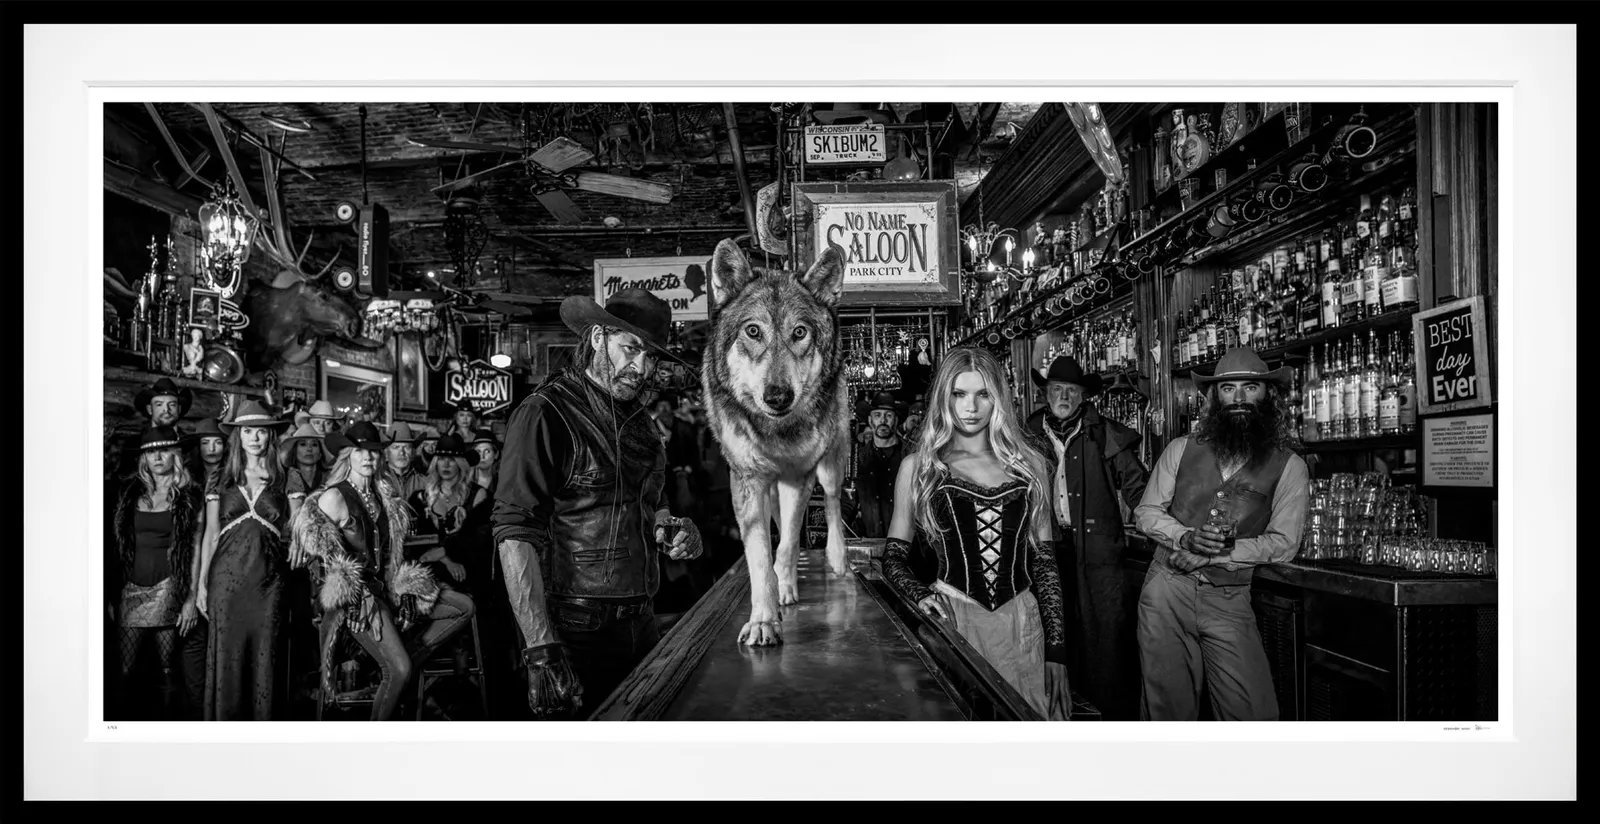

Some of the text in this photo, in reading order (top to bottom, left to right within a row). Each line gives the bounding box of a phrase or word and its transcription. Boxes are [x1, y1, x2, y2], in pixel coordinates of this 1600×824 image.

[808, 126, 850, 134] WISCONSIN
[813, 134, 878, 153] SKIBUM2
[844, 212, 907, 231] NO NAME
[827, 223, 928, 273] SALOON
[850, 267, 903, 276] PARK CITY
[1428, 313, 1472, 347] BEST
[1436, 345, 1471, 377] day
[450, 373, 509, 401] SALOON
[1432, 374, 1476, 402] Ever
[480, 400, 497, 408] CITY
